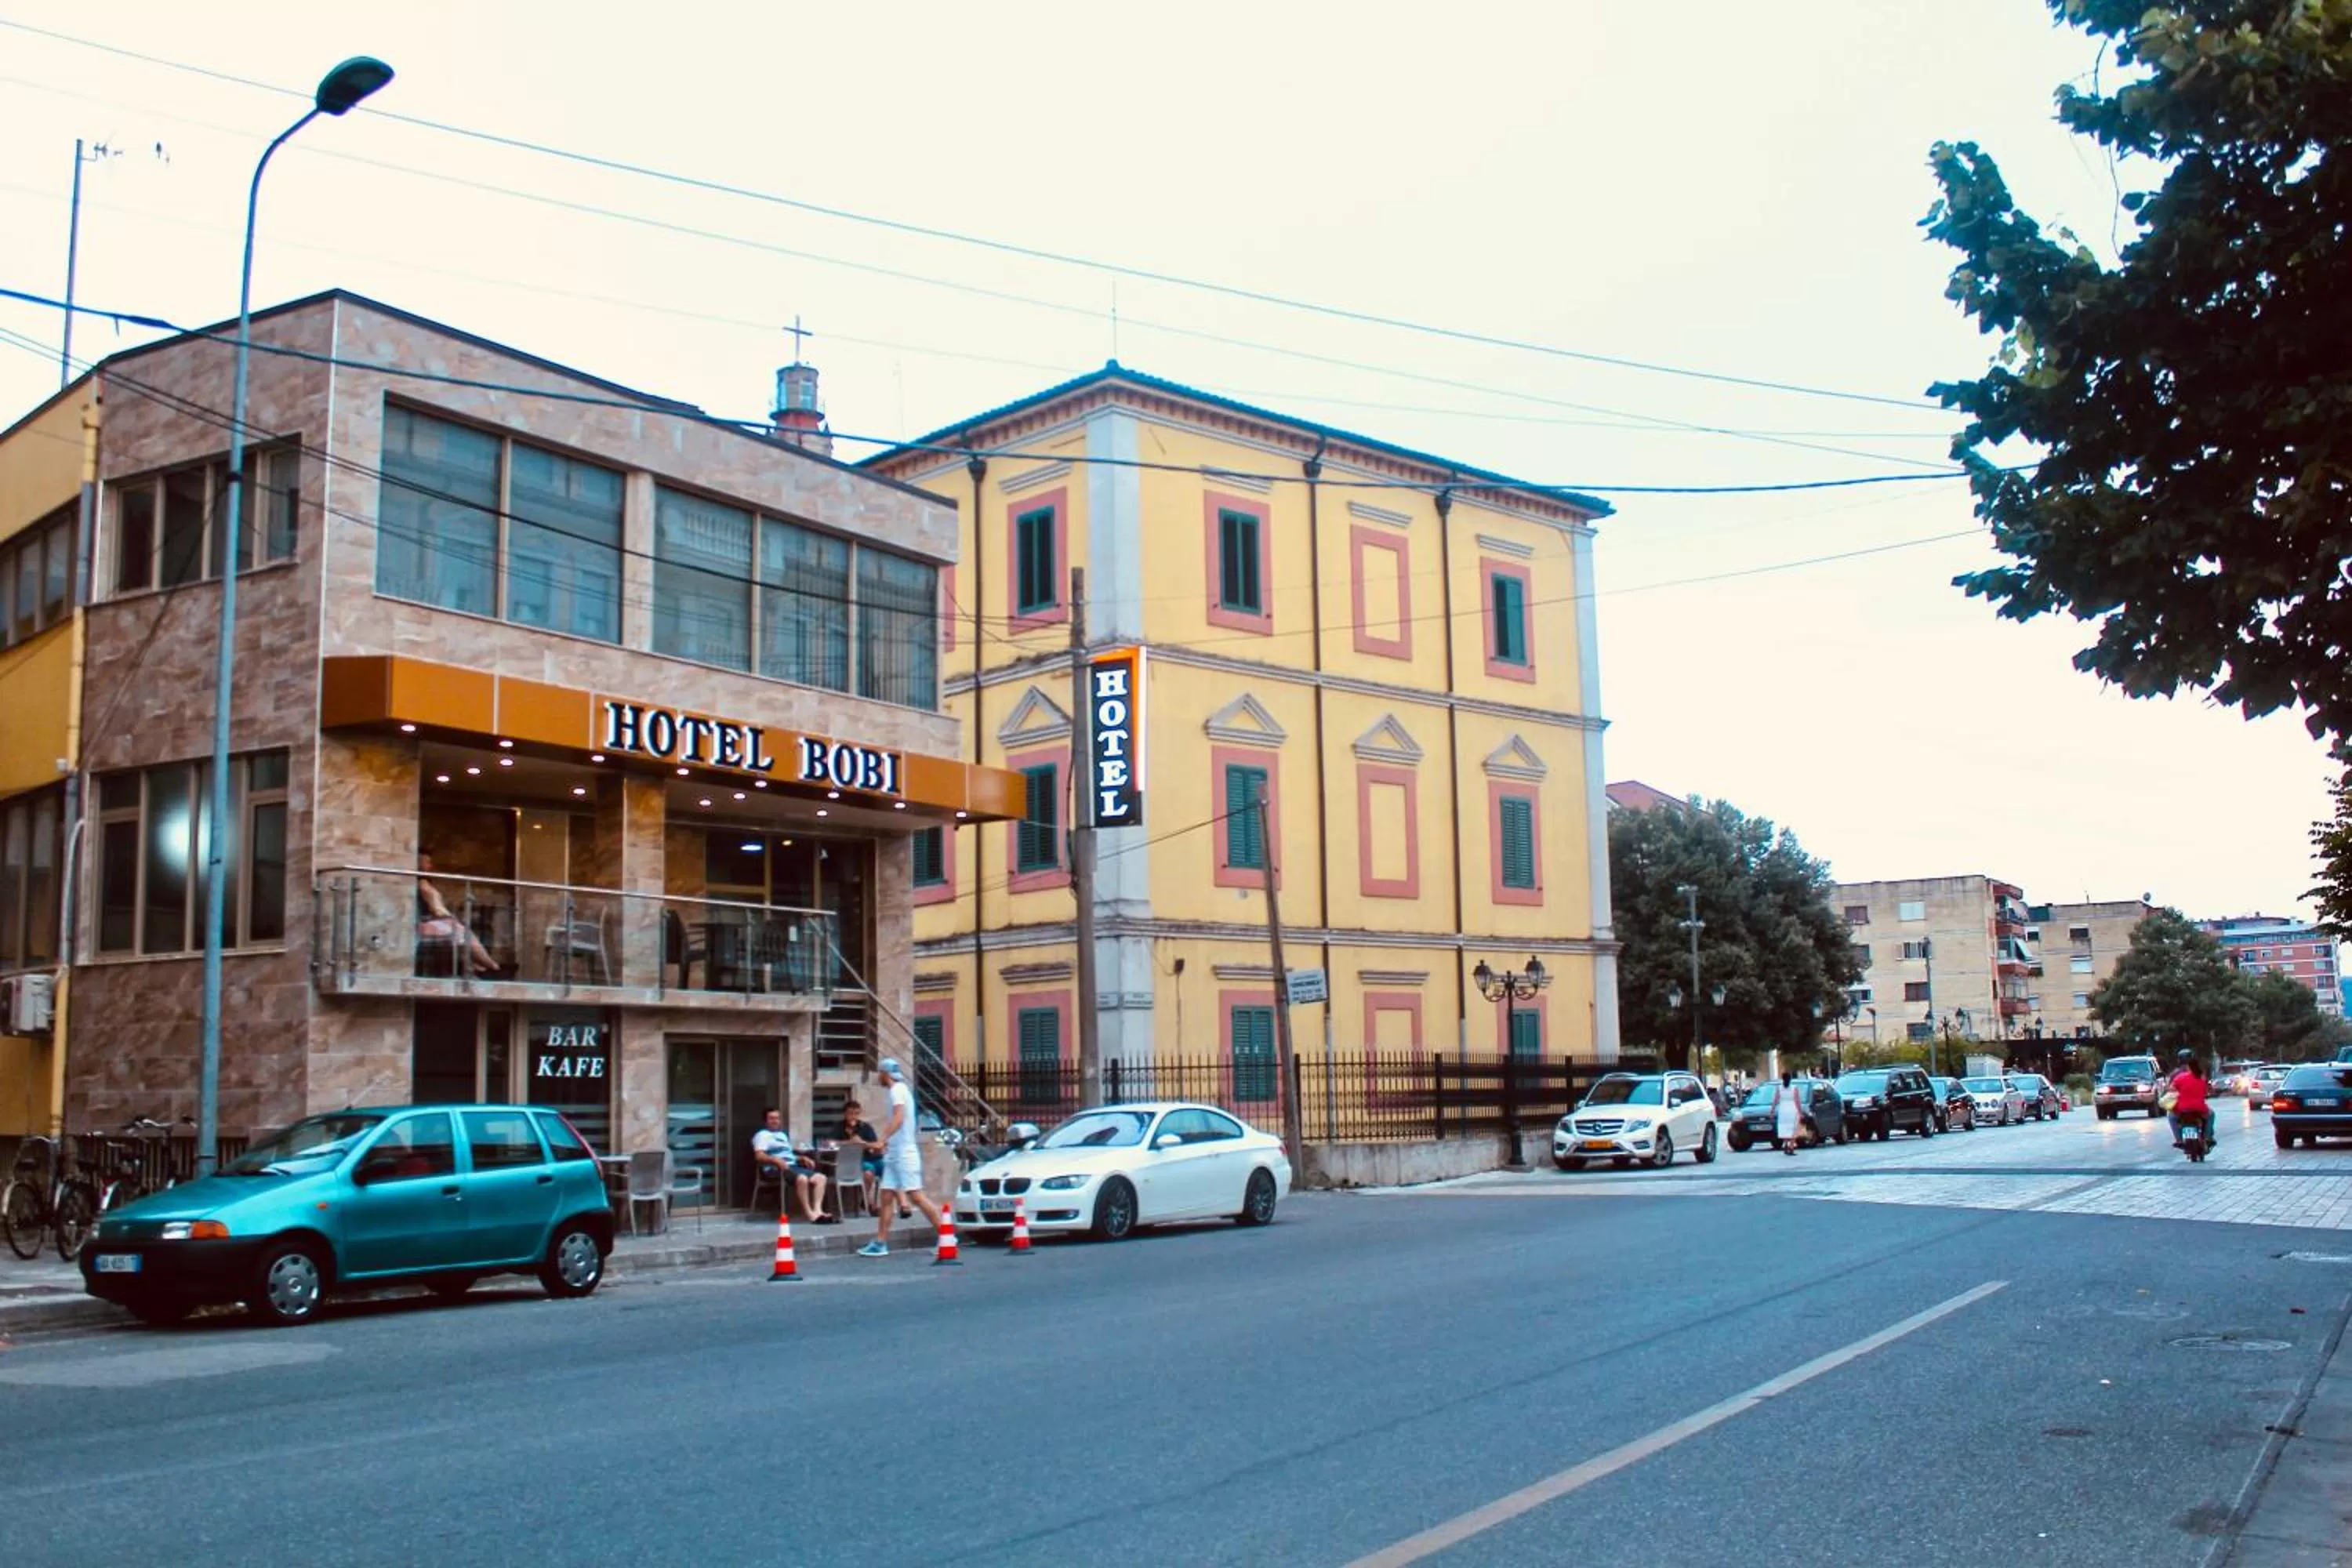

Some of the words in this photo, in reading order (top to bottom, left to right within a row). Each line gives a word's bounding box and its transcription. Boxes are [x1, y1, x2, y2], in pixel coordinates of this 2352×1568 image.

[604, 701, 775, 772] HOTEL
[797, 735, 902, 793] BOBI
[1095, 669, 1129, 818] HOTEL
[546, 1025, 597, 1047] BAR
[536, 1055, 605, 1078] KAFE
